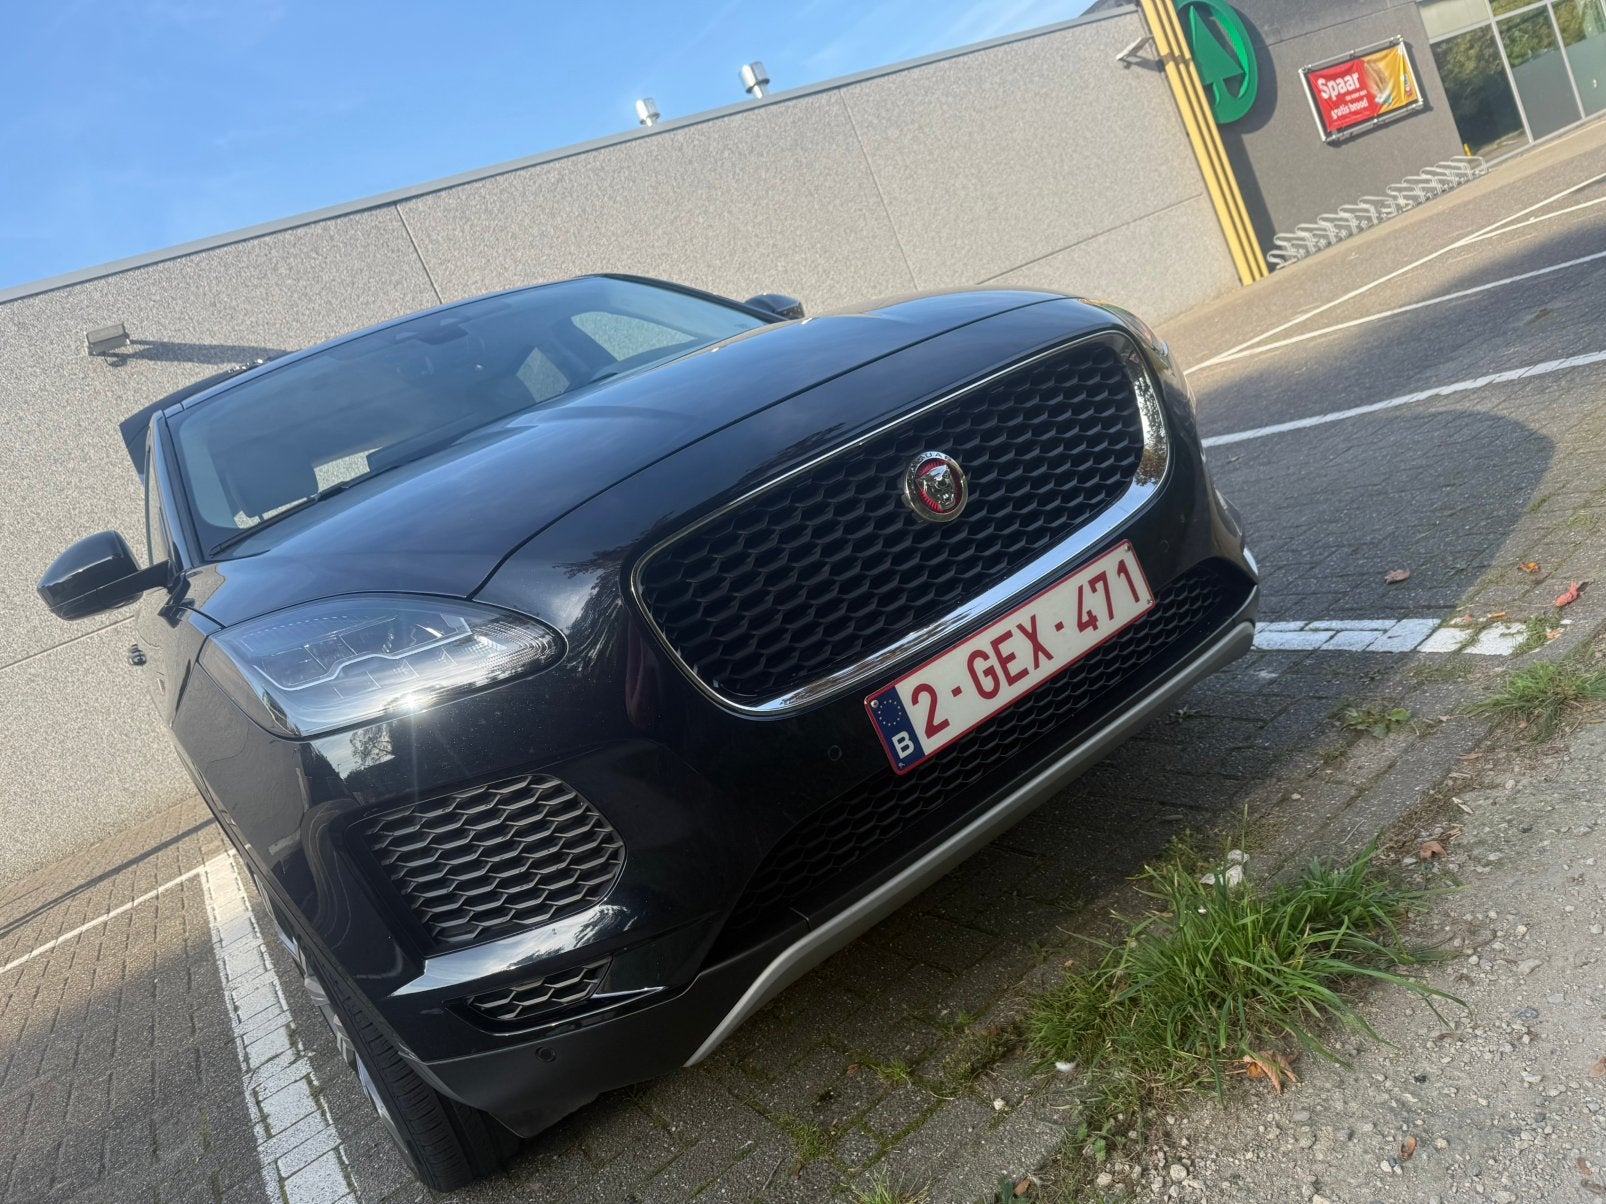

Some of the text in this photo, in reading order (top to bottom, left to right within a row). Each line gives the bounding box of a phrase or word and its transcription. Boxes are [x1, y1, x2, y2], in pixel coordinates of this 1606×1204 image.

[1317, 72, 1360, 100] Spaar
[1331, 99, 1369, 119] gratis brood
[911, 559, 1141, 740] 2-GEX-471
[891, 731, 915, 759] B
